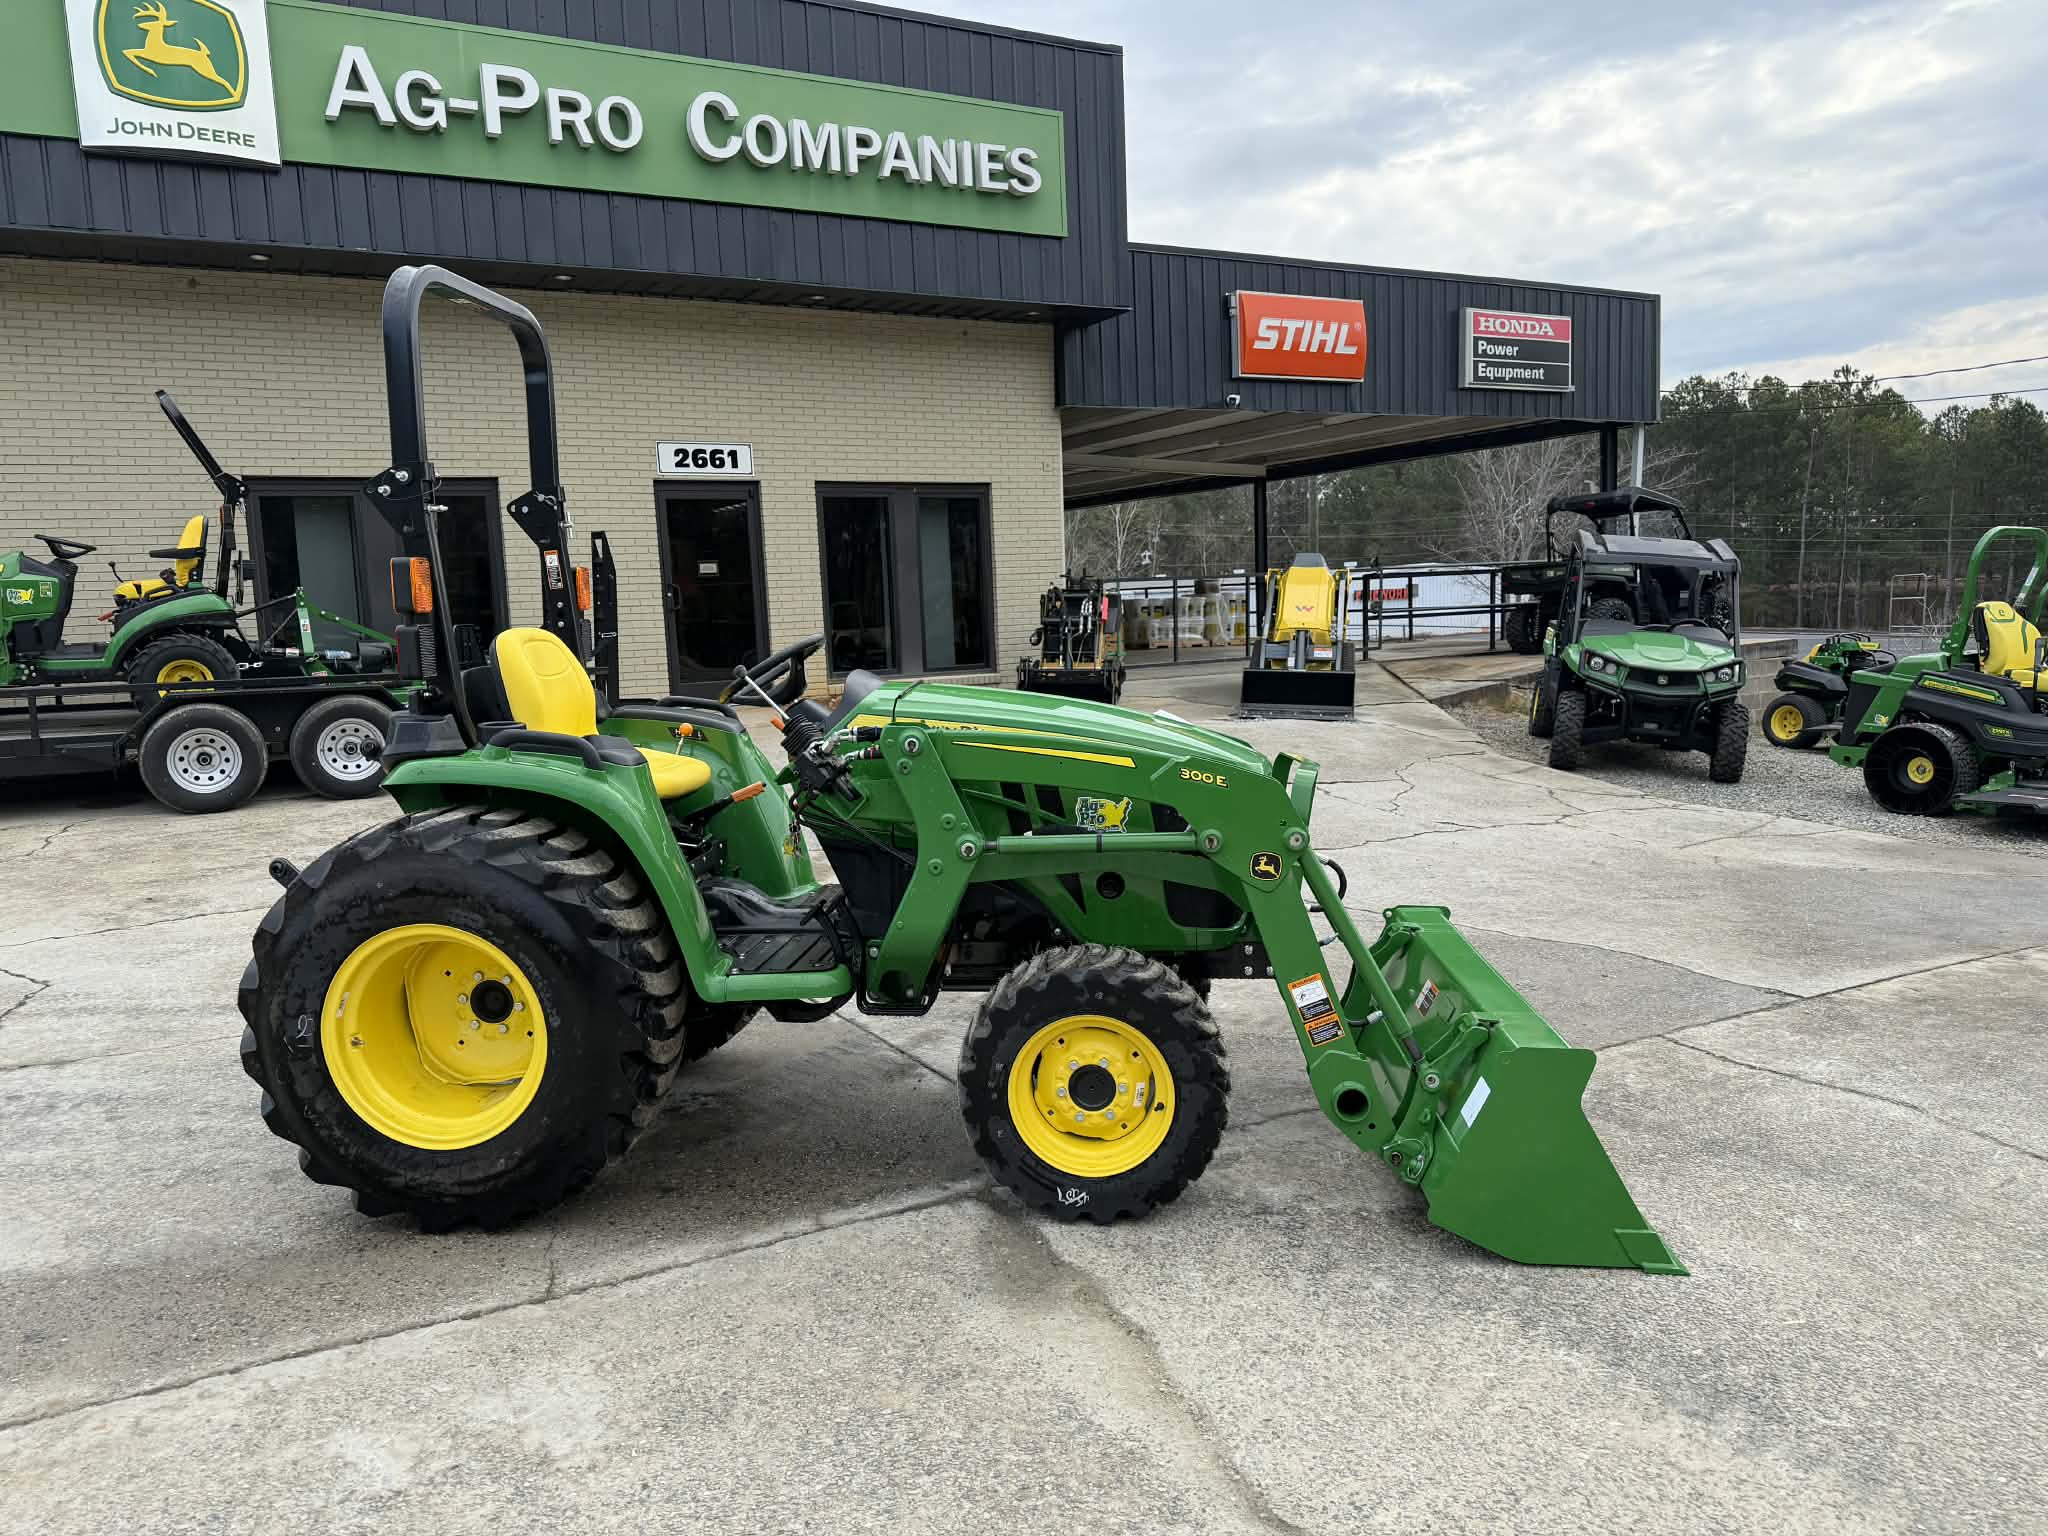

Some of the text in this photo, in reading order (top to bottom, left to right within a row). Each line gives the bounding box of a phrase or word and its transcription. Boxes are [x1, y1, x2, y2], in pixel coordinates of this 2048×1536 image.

[324, 44, 1043, 198] AG-PRO COMPANIES
[1253, 317, 1359, 355] STIHL
[1477, 316, 1555, 336] HONDA
[1477, 340, 1519, 357] Power
[1477, 362, 1545, 381] Equipment
[674, 448, 739, 469] 2661
[1180, 768, 1228, 787] 300E
